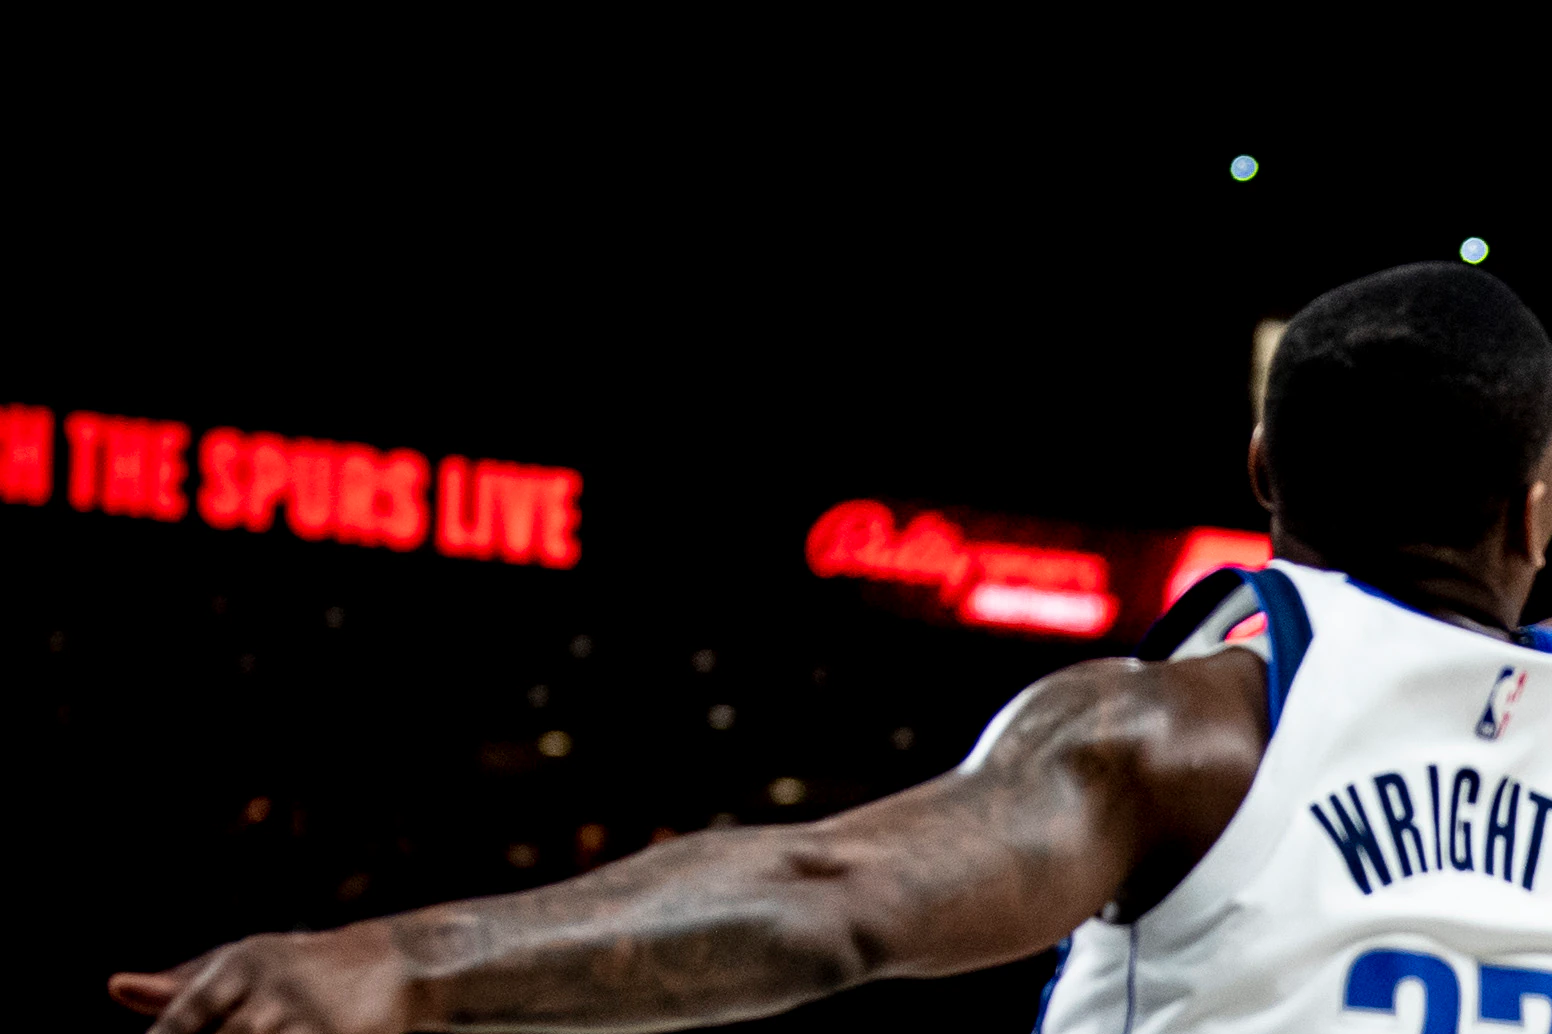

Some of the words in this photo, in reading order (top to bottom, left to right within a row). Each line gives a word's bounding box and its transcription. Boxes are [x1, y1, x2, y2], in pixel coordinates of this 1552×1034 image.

[64, 411, 190, 522] THE
[198, 426, 430, 551] SPURS
[436, 456, 582, 570] LIVE
